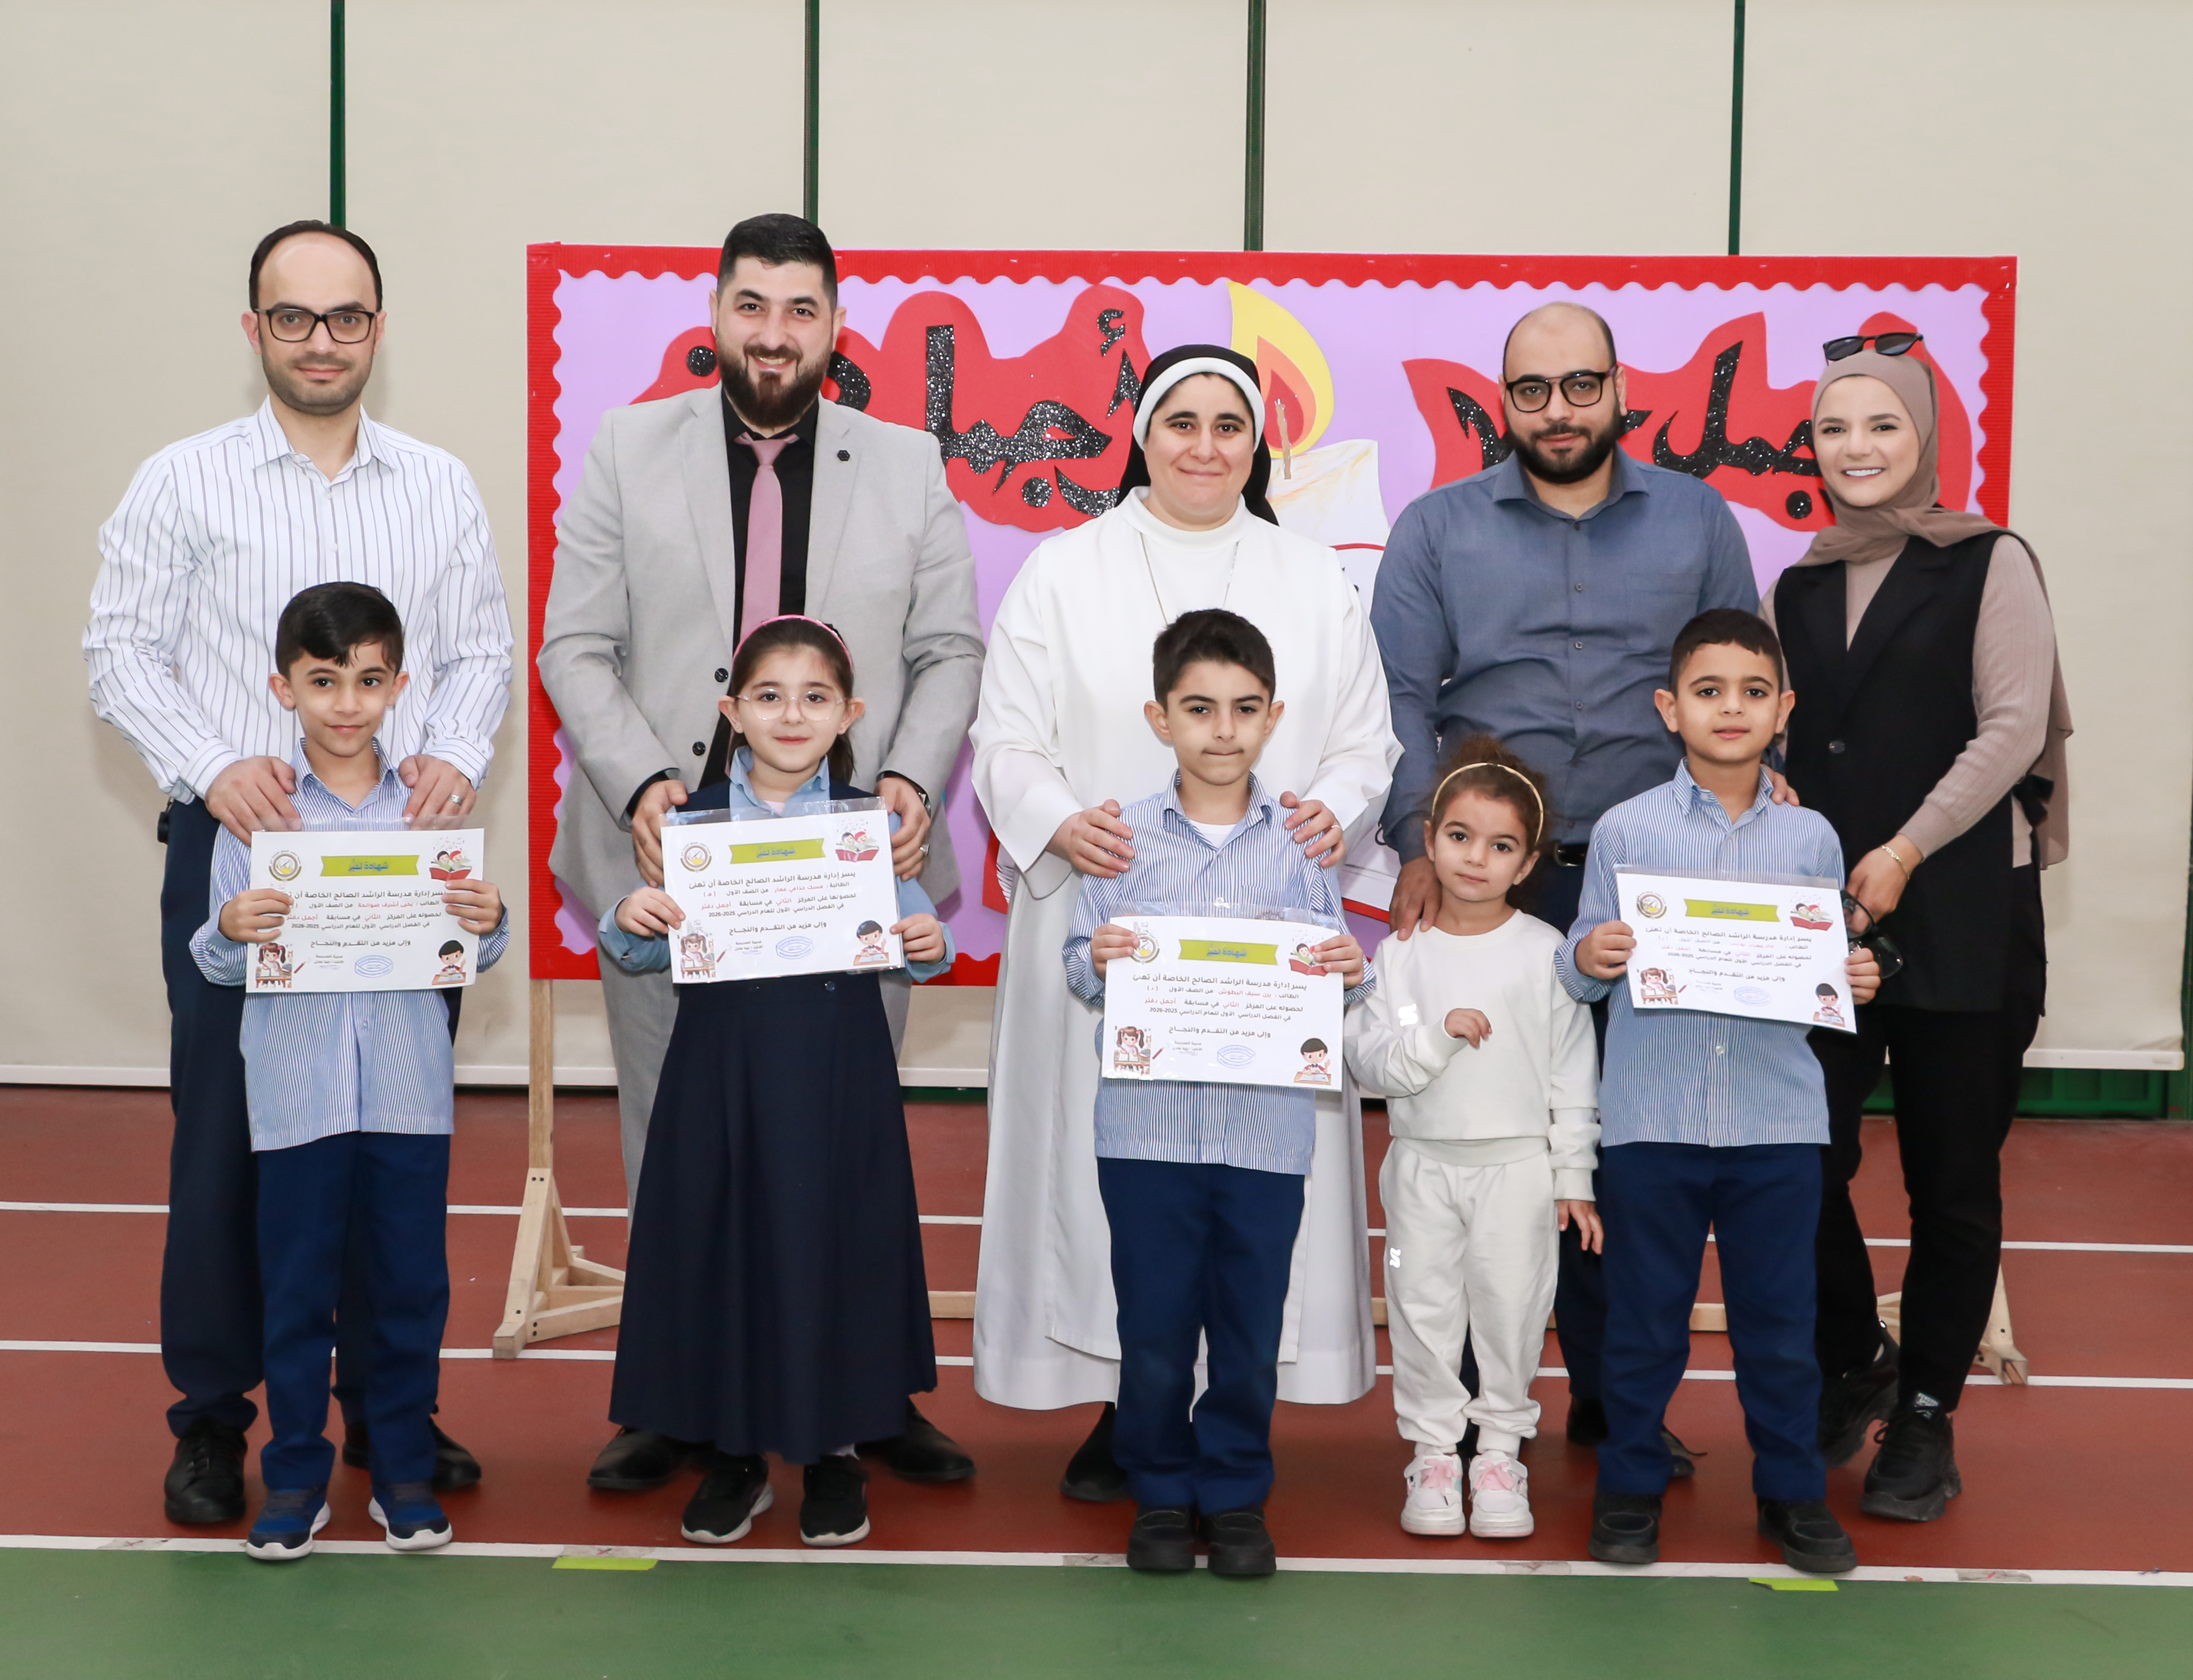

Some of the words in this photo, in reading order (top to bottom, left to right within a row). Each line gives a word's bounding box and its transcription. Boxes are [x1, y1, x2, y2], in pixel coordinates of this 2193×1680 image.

[823, 872, 839, 880] إدارة
[707, 879, 716, 888] أن
[745, 877, 770, 887] الصالح
[715, 900, 731, 909] أجمل
[775, 897, 791, 906] الثاني
[1152, 972, 1161, 982] أن
[1191, 977, 1218, 985] الصالح
[1219, 977, 1244, 986] الراشد
[1245, 979, 1271, 987] مدرسة
[1273, 980, 1289, 990] إدارة
[1222, 1000, 1239, 1009] الثاني
